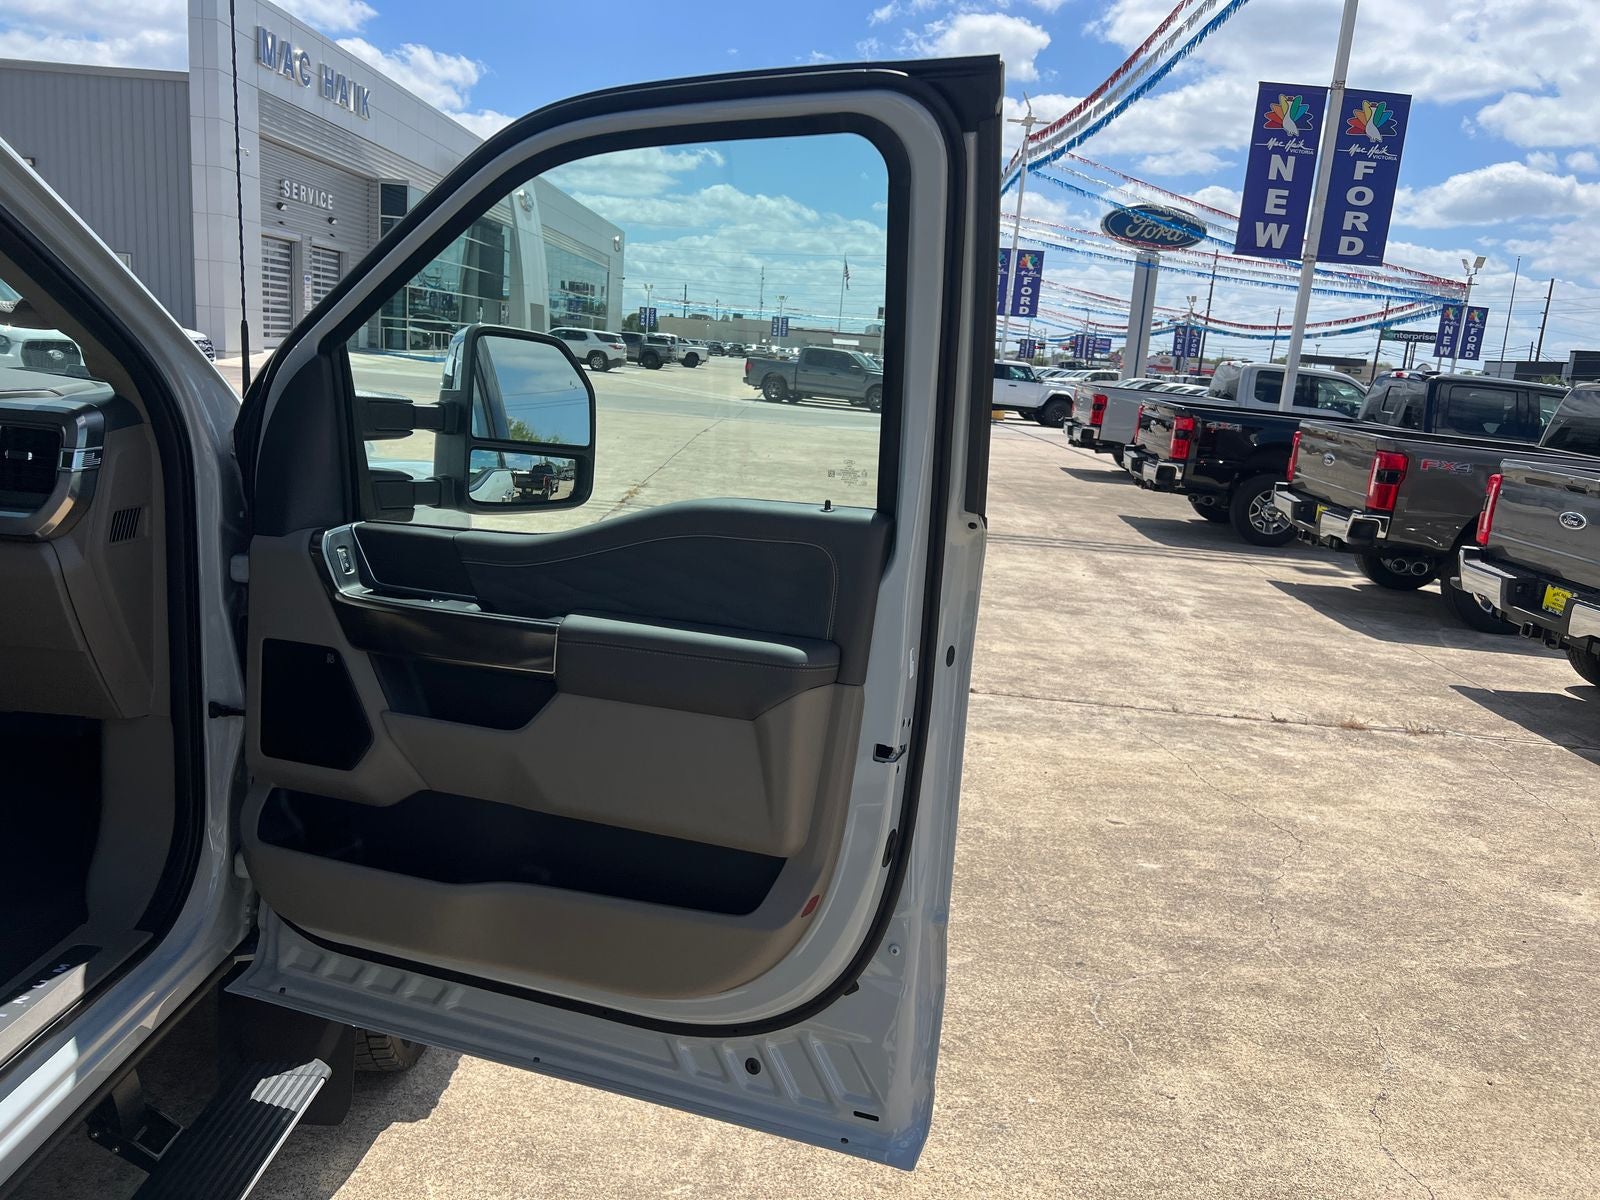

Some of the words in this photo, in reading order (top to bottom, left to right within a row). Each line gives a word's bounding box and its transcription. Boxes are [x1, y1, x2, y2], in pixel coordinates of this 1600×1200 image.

[256, 25, 312, 88] MAC
[320, 62, 371, 121] HAIK
[281, 178, 334, 210] SERVICE
[1255, 154, 1296, 249] NEW
[1337, 160, 1377, 256] FORD
[1125, 208, 1186, 241] Ford
[1018, 276, 1032, 315] FORD
[1384, 331, 1436, 341] enterprise
[1440, 325, 1454, 356] NEW
[1464, 327, 1478, 358] FORD
[1420, 459, 1473, 473] FX4
